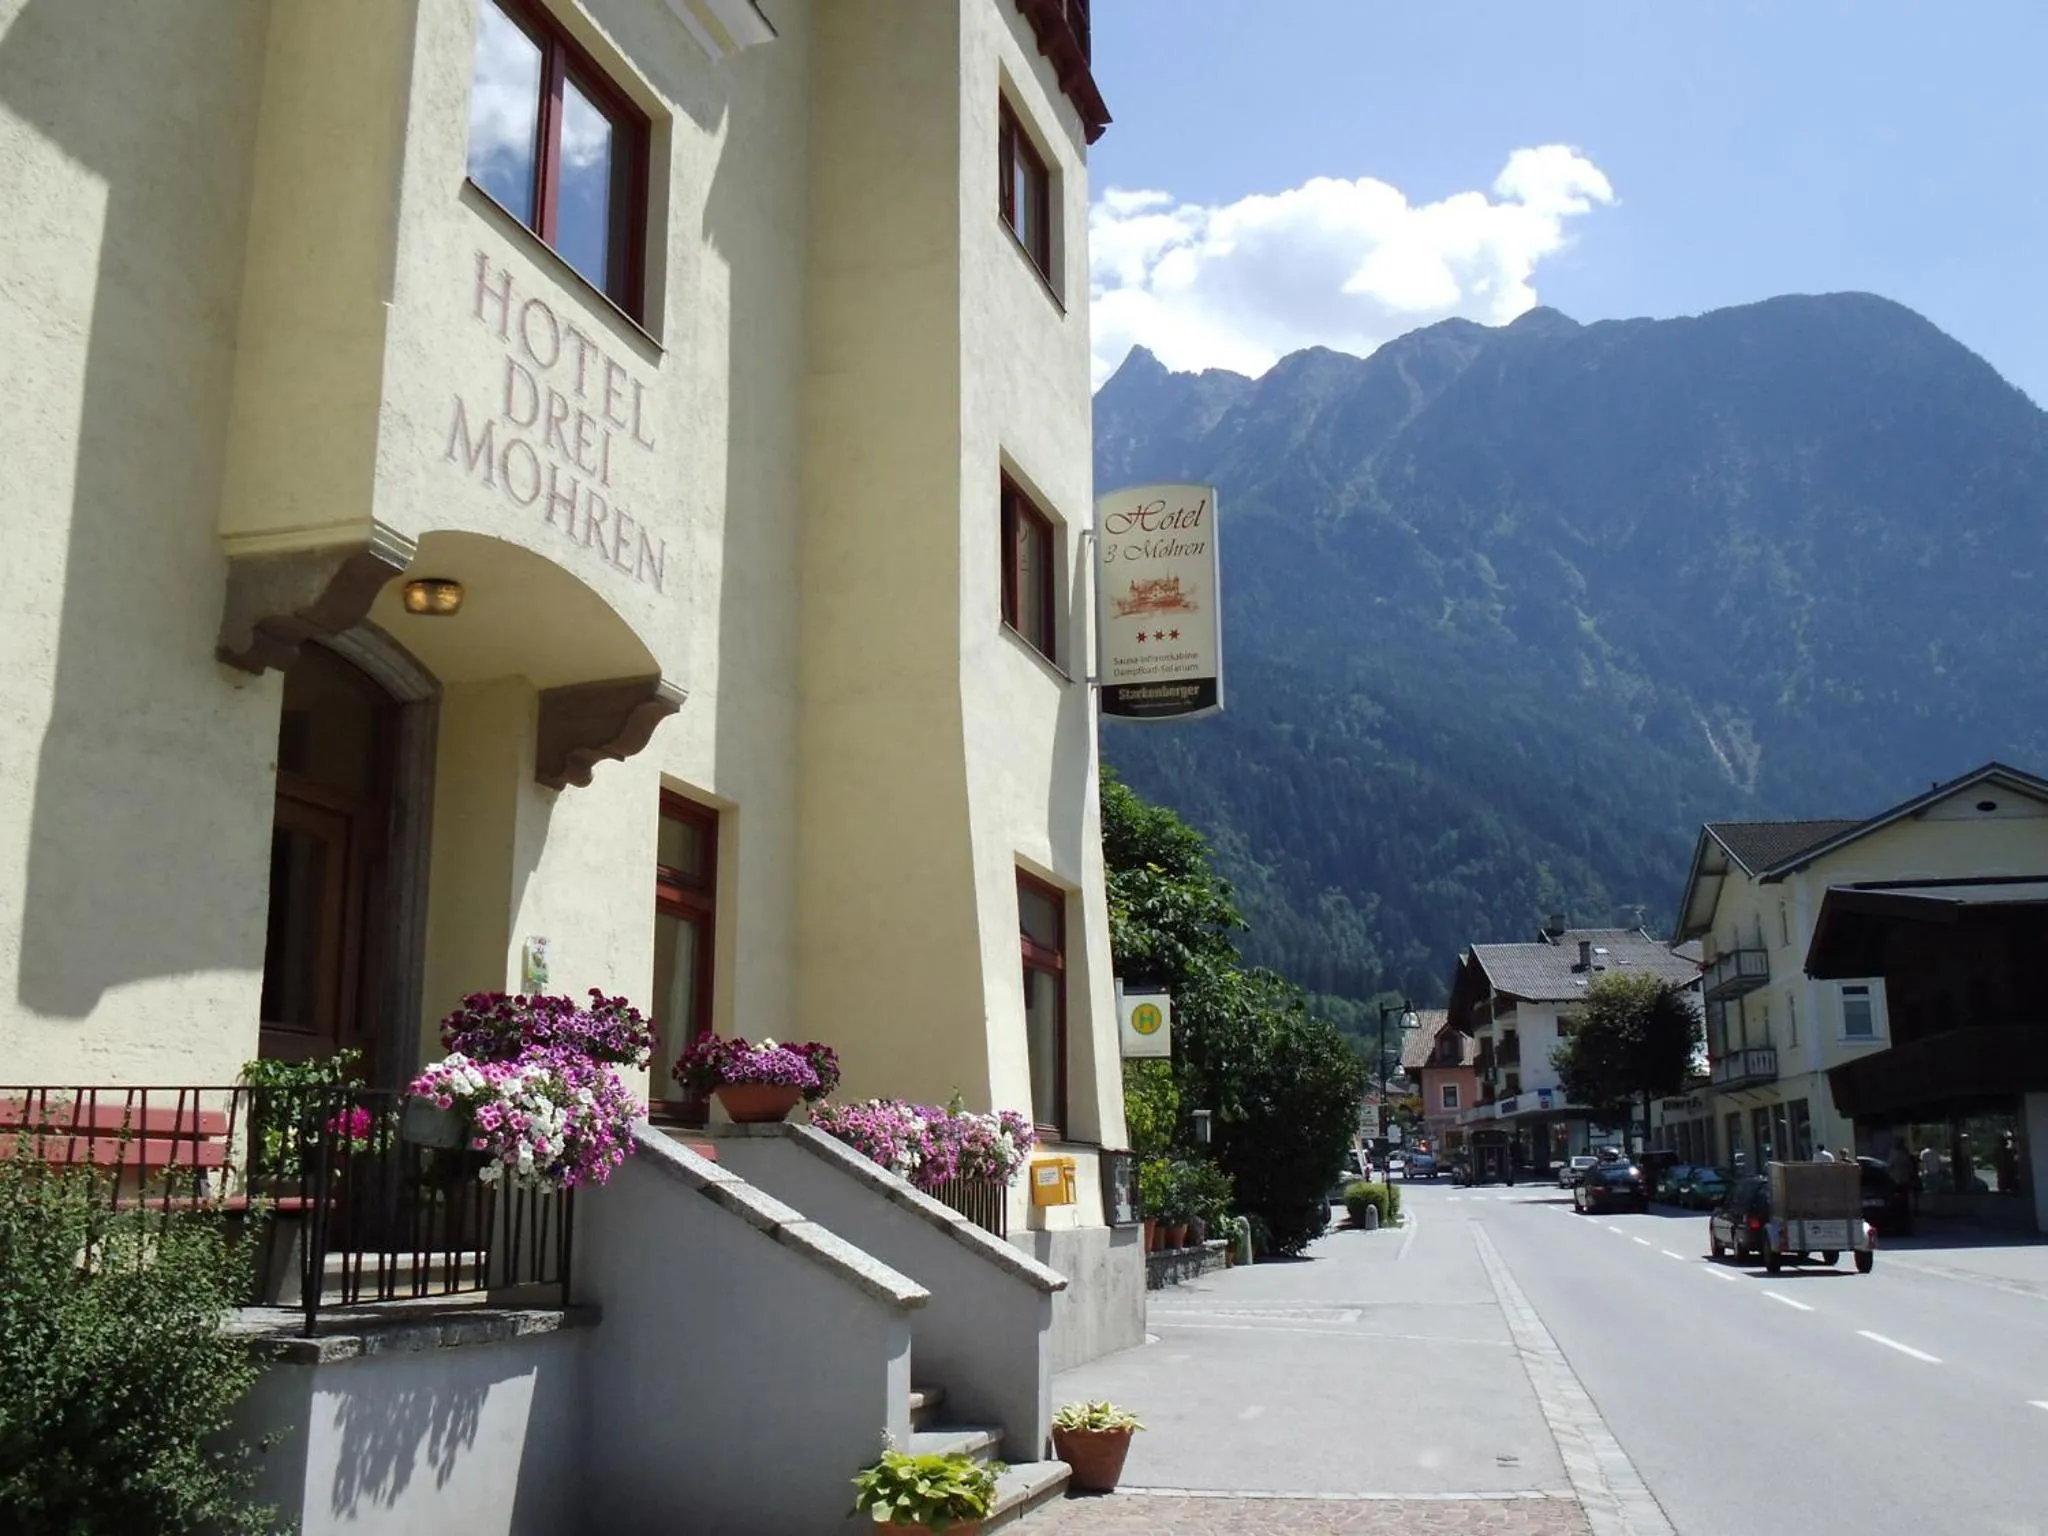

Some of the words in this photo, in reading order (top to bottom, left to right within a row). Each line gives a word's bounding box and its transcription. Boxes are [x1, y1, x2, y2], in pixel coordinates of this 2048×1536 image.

[473, 249, 656, 452] HOTEL
[503, 354, 612, 489] DREI
[445, 393, 667, 594] MOHREN
[1105, 499, 1206, 535] Hotel
[1103, 543, 1118, 564] 3
[1139, 1010, 1155, 1029] H
